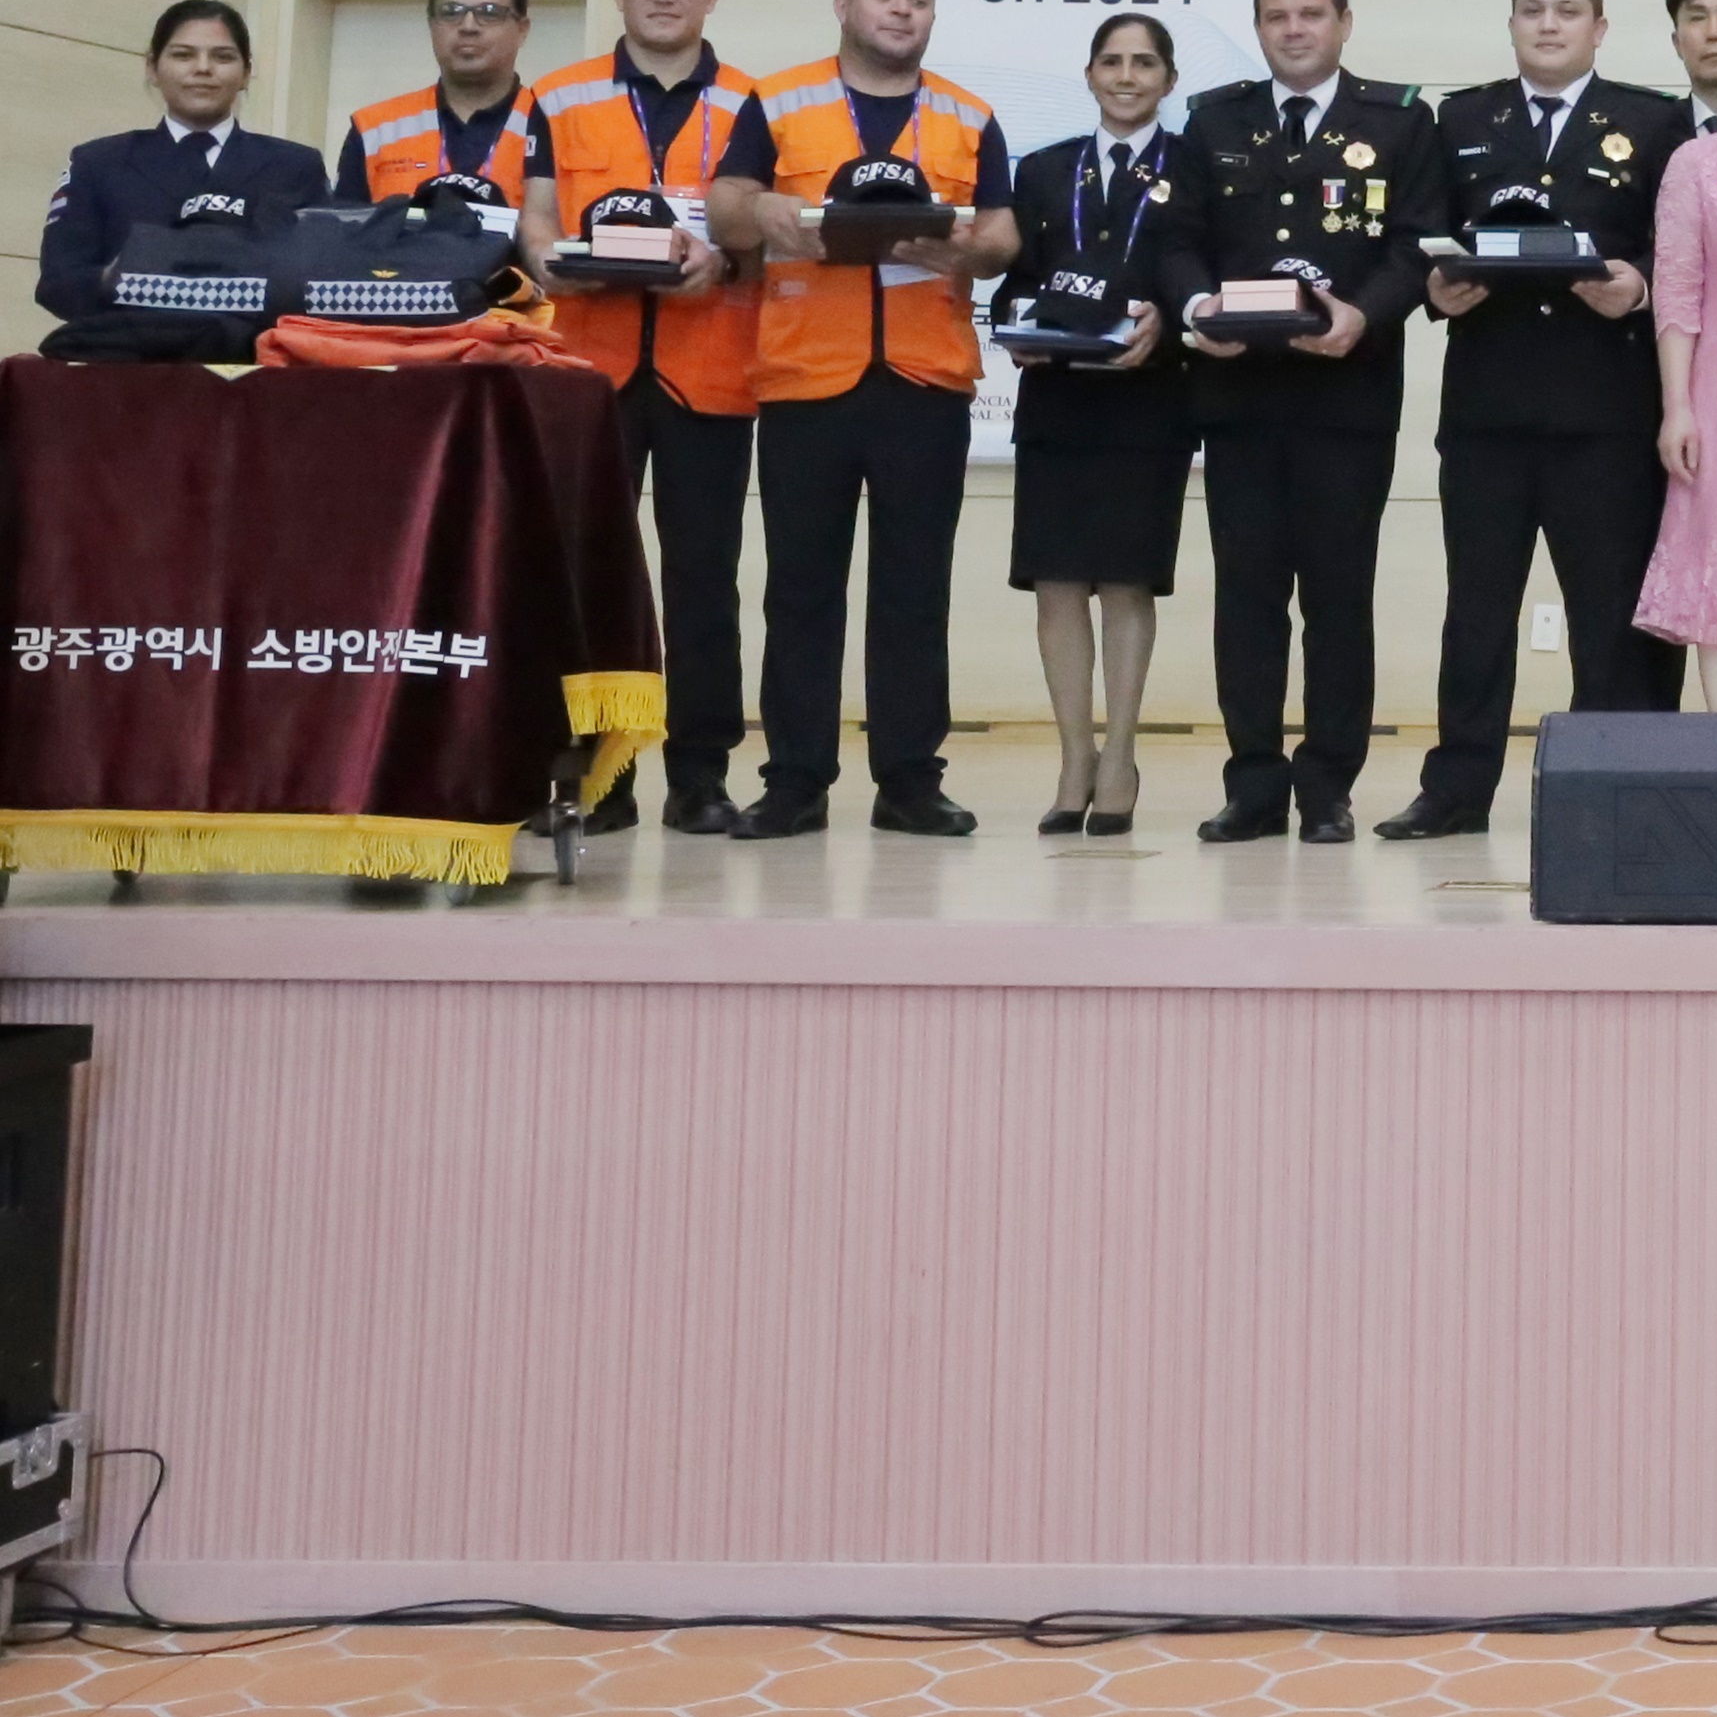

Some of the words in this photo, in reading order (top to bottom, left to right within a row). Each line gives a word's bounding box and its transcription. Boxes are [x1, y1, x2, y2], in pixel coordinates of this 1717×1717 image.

[852, 162, 915, 186] GFSA
[180, 193, 245, 220] GFSA
[591, 195, 652, 225] GFSA
[1490, 185, 1549, 210] GFSA
[1052, 270, 1107, 302] GFSA
[10, 626, 223, 672] 광주광역시
